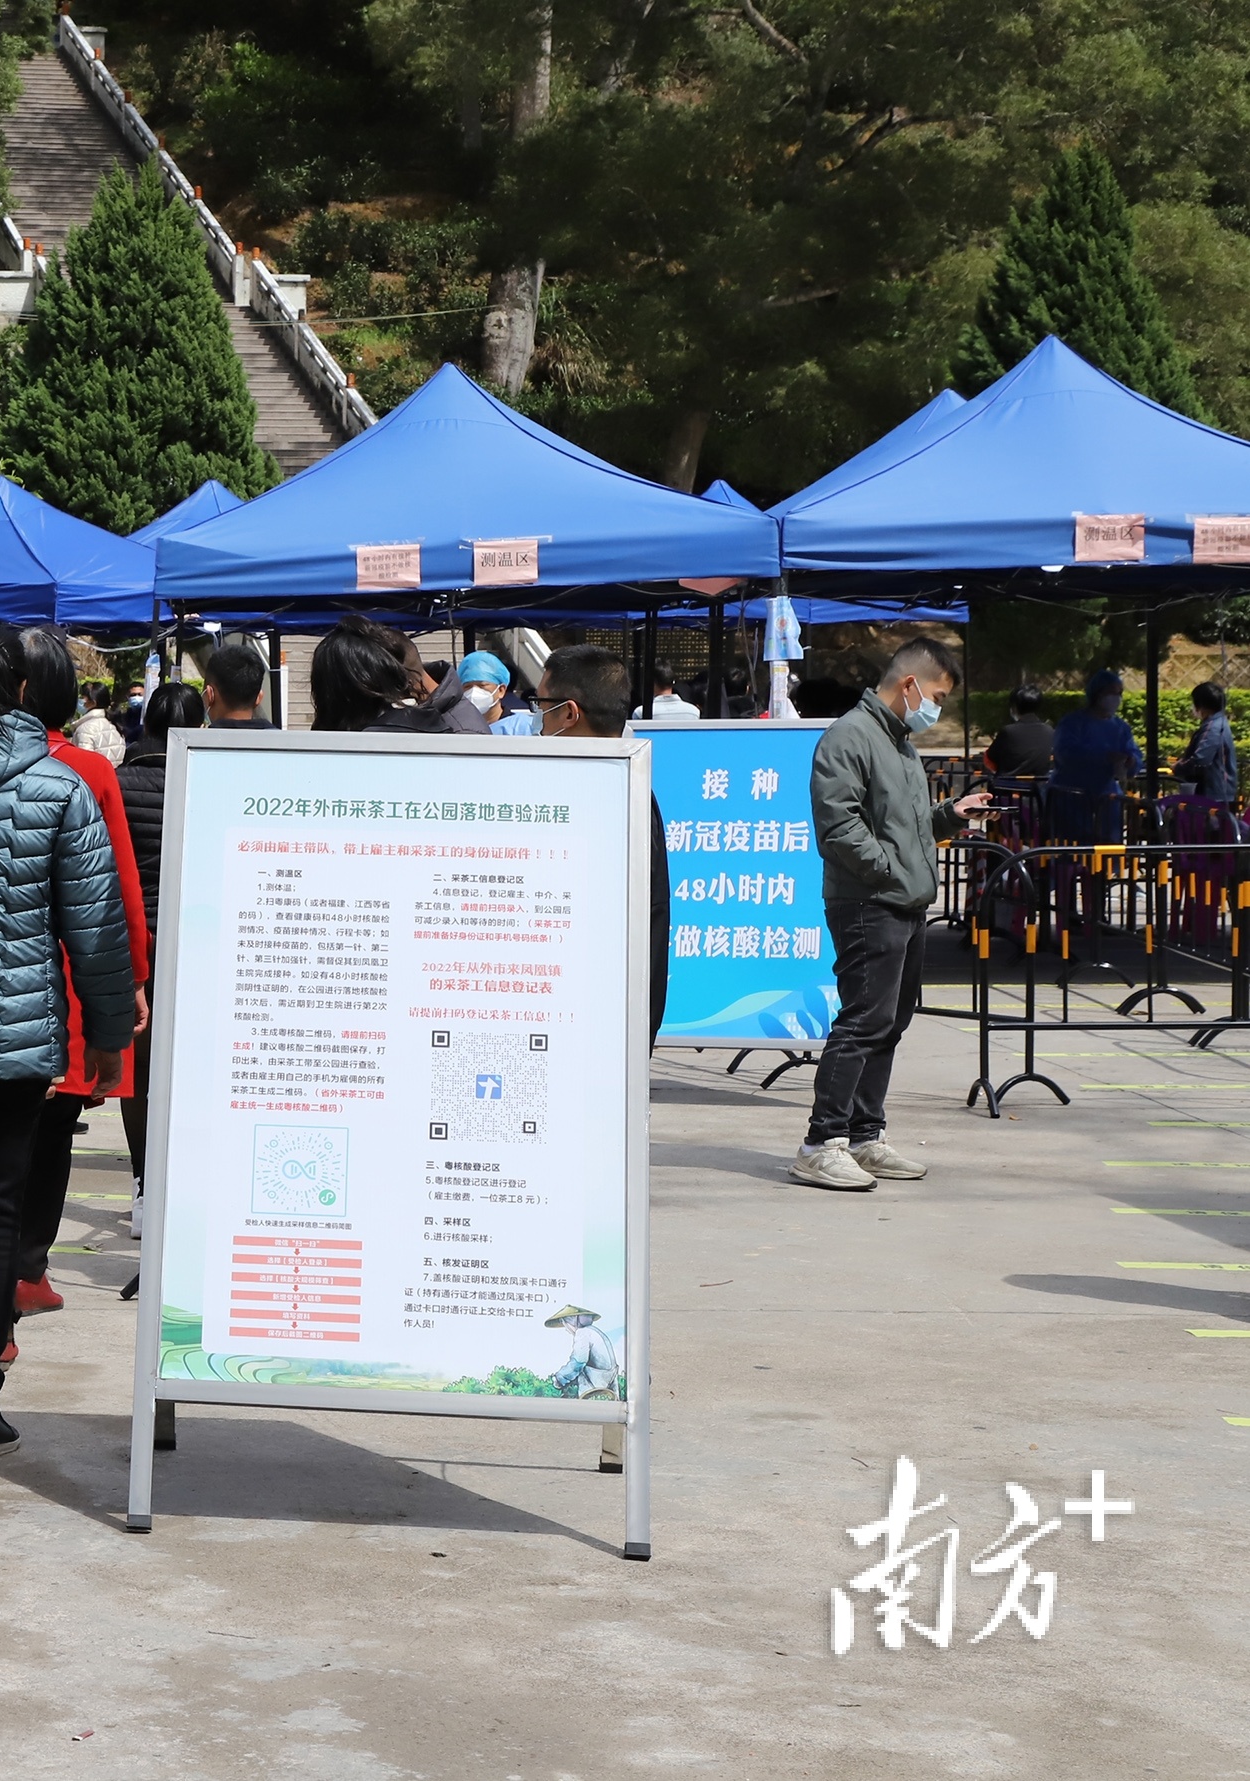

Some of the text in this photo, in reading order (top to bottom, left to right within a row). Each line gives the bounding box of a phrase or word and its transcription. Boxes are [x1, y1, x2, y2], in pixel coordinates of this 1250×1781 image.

[1084, 526, 1135, 542] 测温区
[480, 551, 531, 568] 测温区
[243, 797, 570, 824] 2022年外市采茶工在公园落地查验流程
[665, 820, 810, 853] 新冠疫苗后
[258, 869, 302, 878] 一、测温区
[433, 873, 524, 884] 二、采茶工信息登记区
[674, 872, 795, 905] 48小时内
[668, 925, 821, 960] 做核酸检测
[422, 961, 563, 977] 2022年从外市来凤凰镇
[429, 978, 553, 994] 的采茶工信息登记表
[234, 1012, 275, 1022] 核酸检测。
[425, 1160, 500, 1172] 三、粤核酸登记区
[425, 1176, 527, 1189] 5.粤核酸登记区进行登记
[424, 1216, 471, 1227] 四、采样区
[423, 1257, 489, 1269] 五、核发证明区
[404, 1303, 534, 1318] 通过卡口时通行证上交给卡口工
